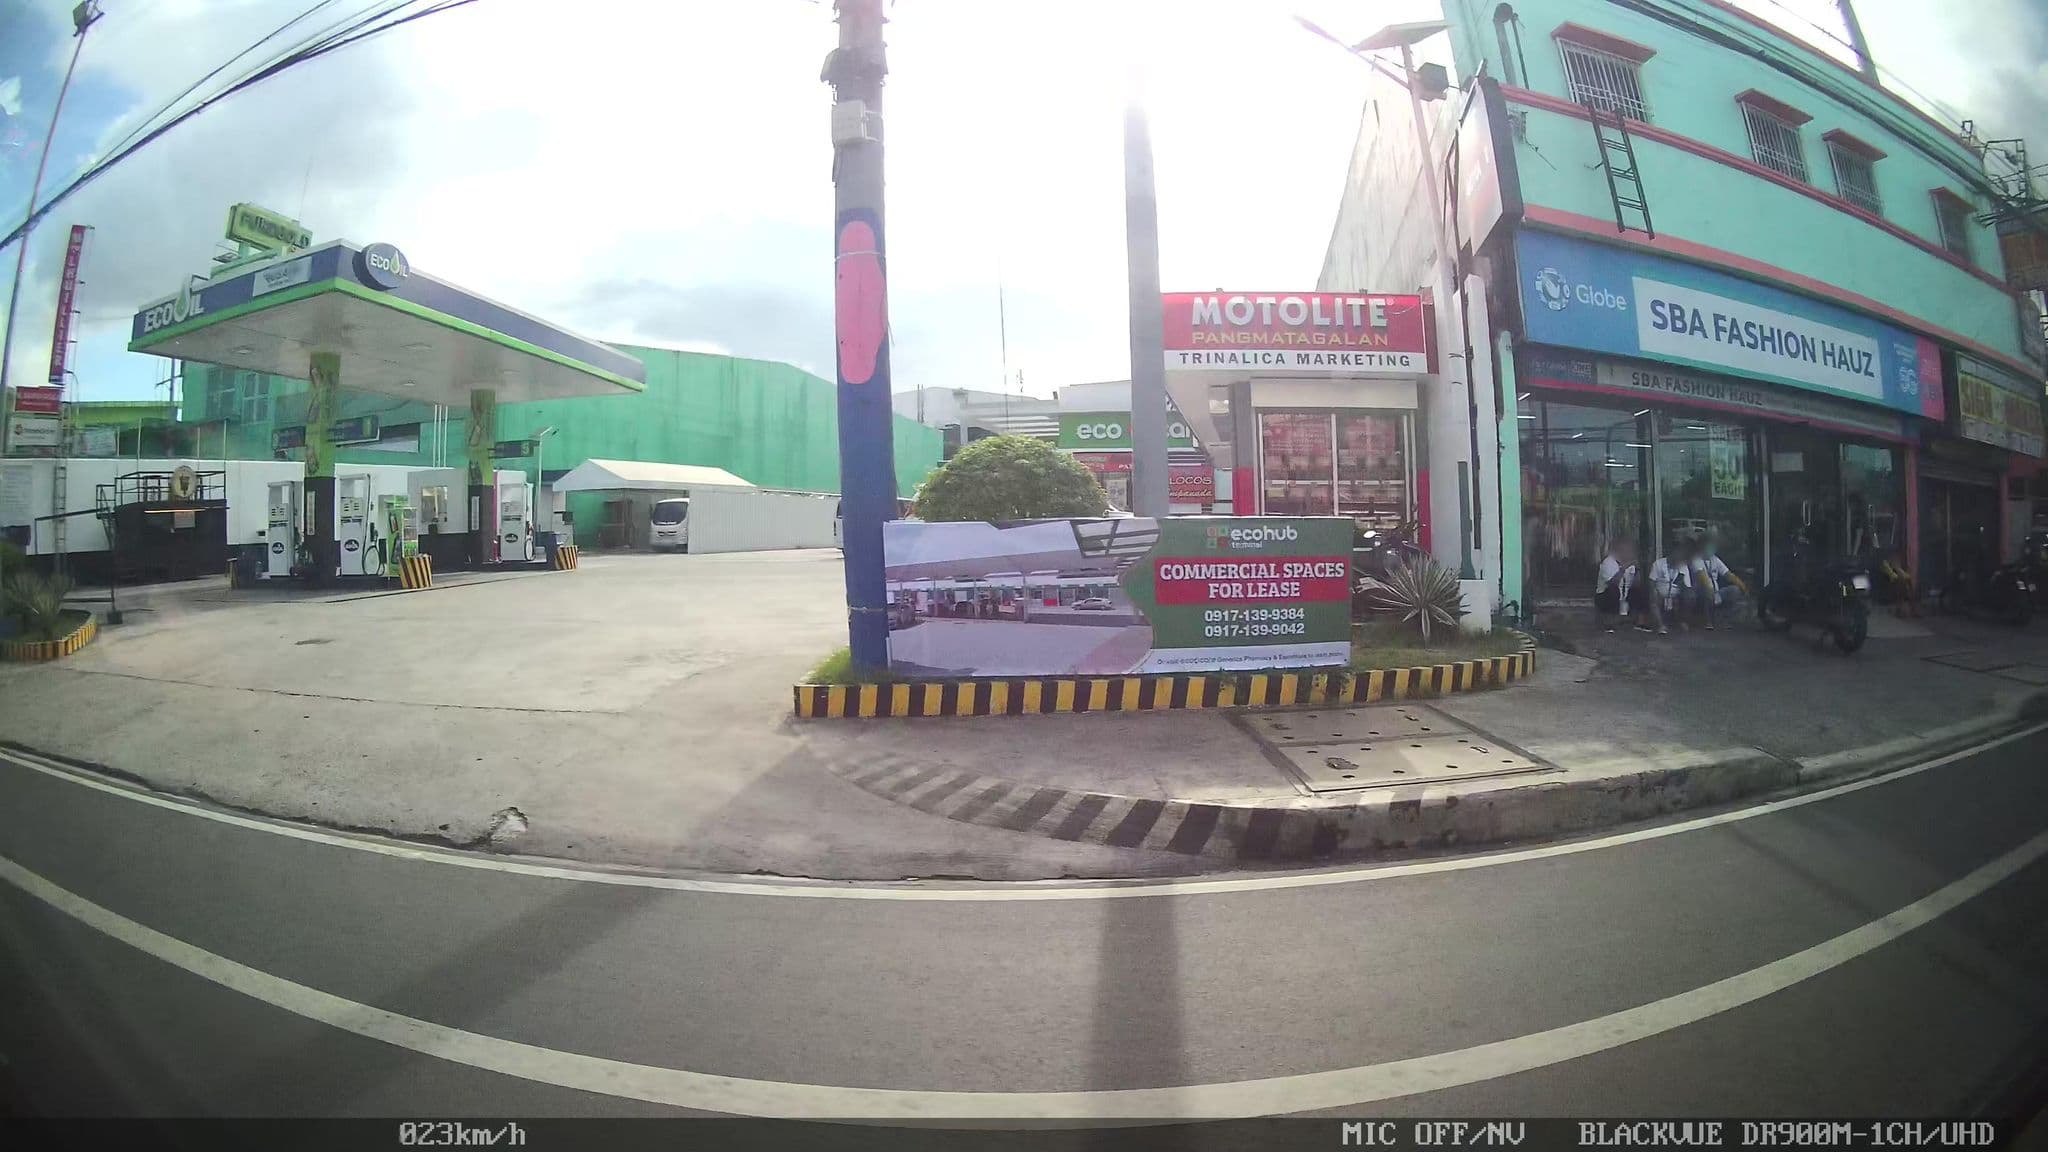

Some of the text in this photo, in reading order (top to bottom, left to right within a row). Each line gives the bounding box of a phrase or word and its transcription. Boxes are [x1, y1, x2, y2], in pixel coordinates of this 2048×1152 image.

[1576, 284, 1627, 311] Globe
[1192, 296, 1389, 327] MOTOLITE
[1192, 331, 1389, 346] PANGMATAGALAN
[1651, 299, 1708, 339] SBA
[1713, 313, 1817, 363] FASHION
[1821, 340, 1874, 378] HAUZ
[1180, 352, 1410, 367] TRINALICA MARKETING
[1632, 371, 1763, 406] SBA FASHION HAUZ
[1077, 423, 1122, 439] eco
[1231, 525, 1298, 541] ecohub
[1160, 562, 1345, 580] COMMERCIAL SPACES
[1208, 582, 1300, 599] FOR LEASE
[1204, 608, 1305, 622] 0917-139-9384
[1204, 623, 1305, 637] 0917-139-9042
